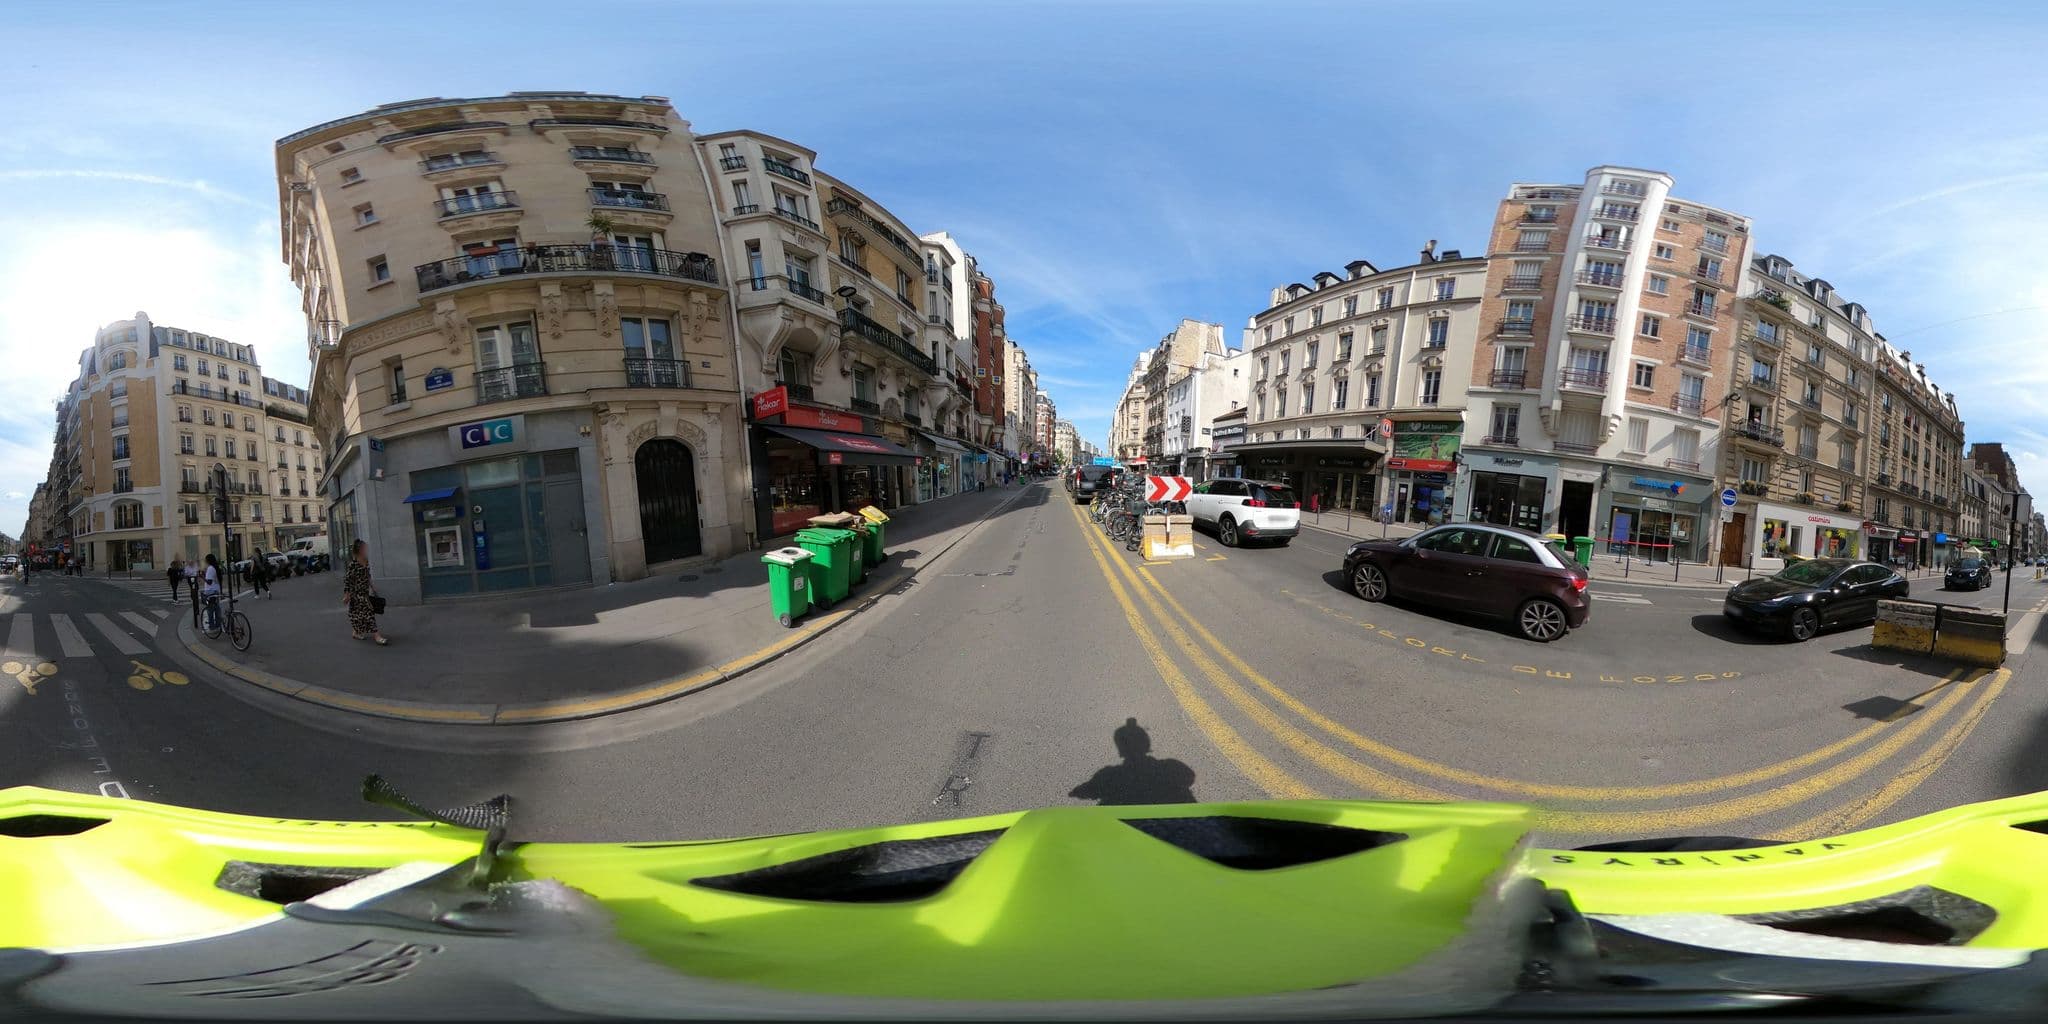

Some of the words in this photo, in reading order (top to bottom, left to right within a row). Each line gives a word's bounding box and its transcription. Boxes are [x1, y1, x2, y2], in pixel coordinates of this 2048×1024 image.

[466, 424, 509, 443] CIC
[1512, 665, 1572, 679] DE
[1600, 671, 1742, 684] FONDS
